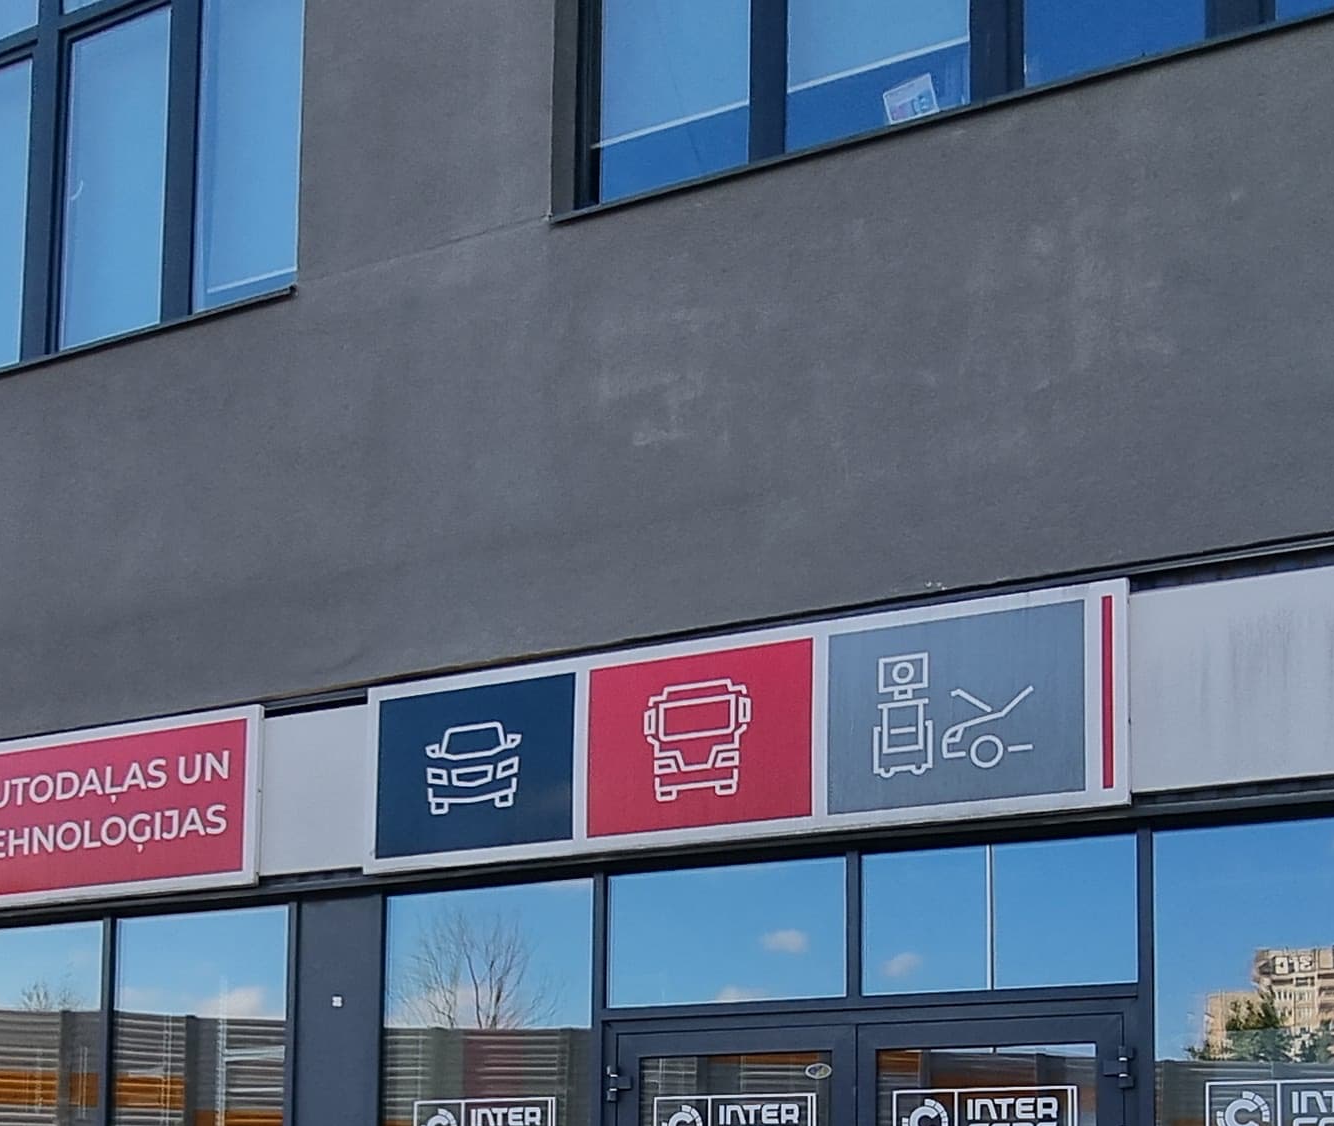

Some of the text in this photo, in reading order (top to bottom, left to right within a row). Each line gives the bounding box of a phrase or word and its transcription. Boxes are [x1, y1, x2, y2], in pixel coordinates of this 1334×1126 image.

[178, 750, 230, 785] UN
[470, 1107, 541, 1126] INTER
[719, 1103, 800, 1126] INTER
[967, 1097, 1059, 1120] INTER
